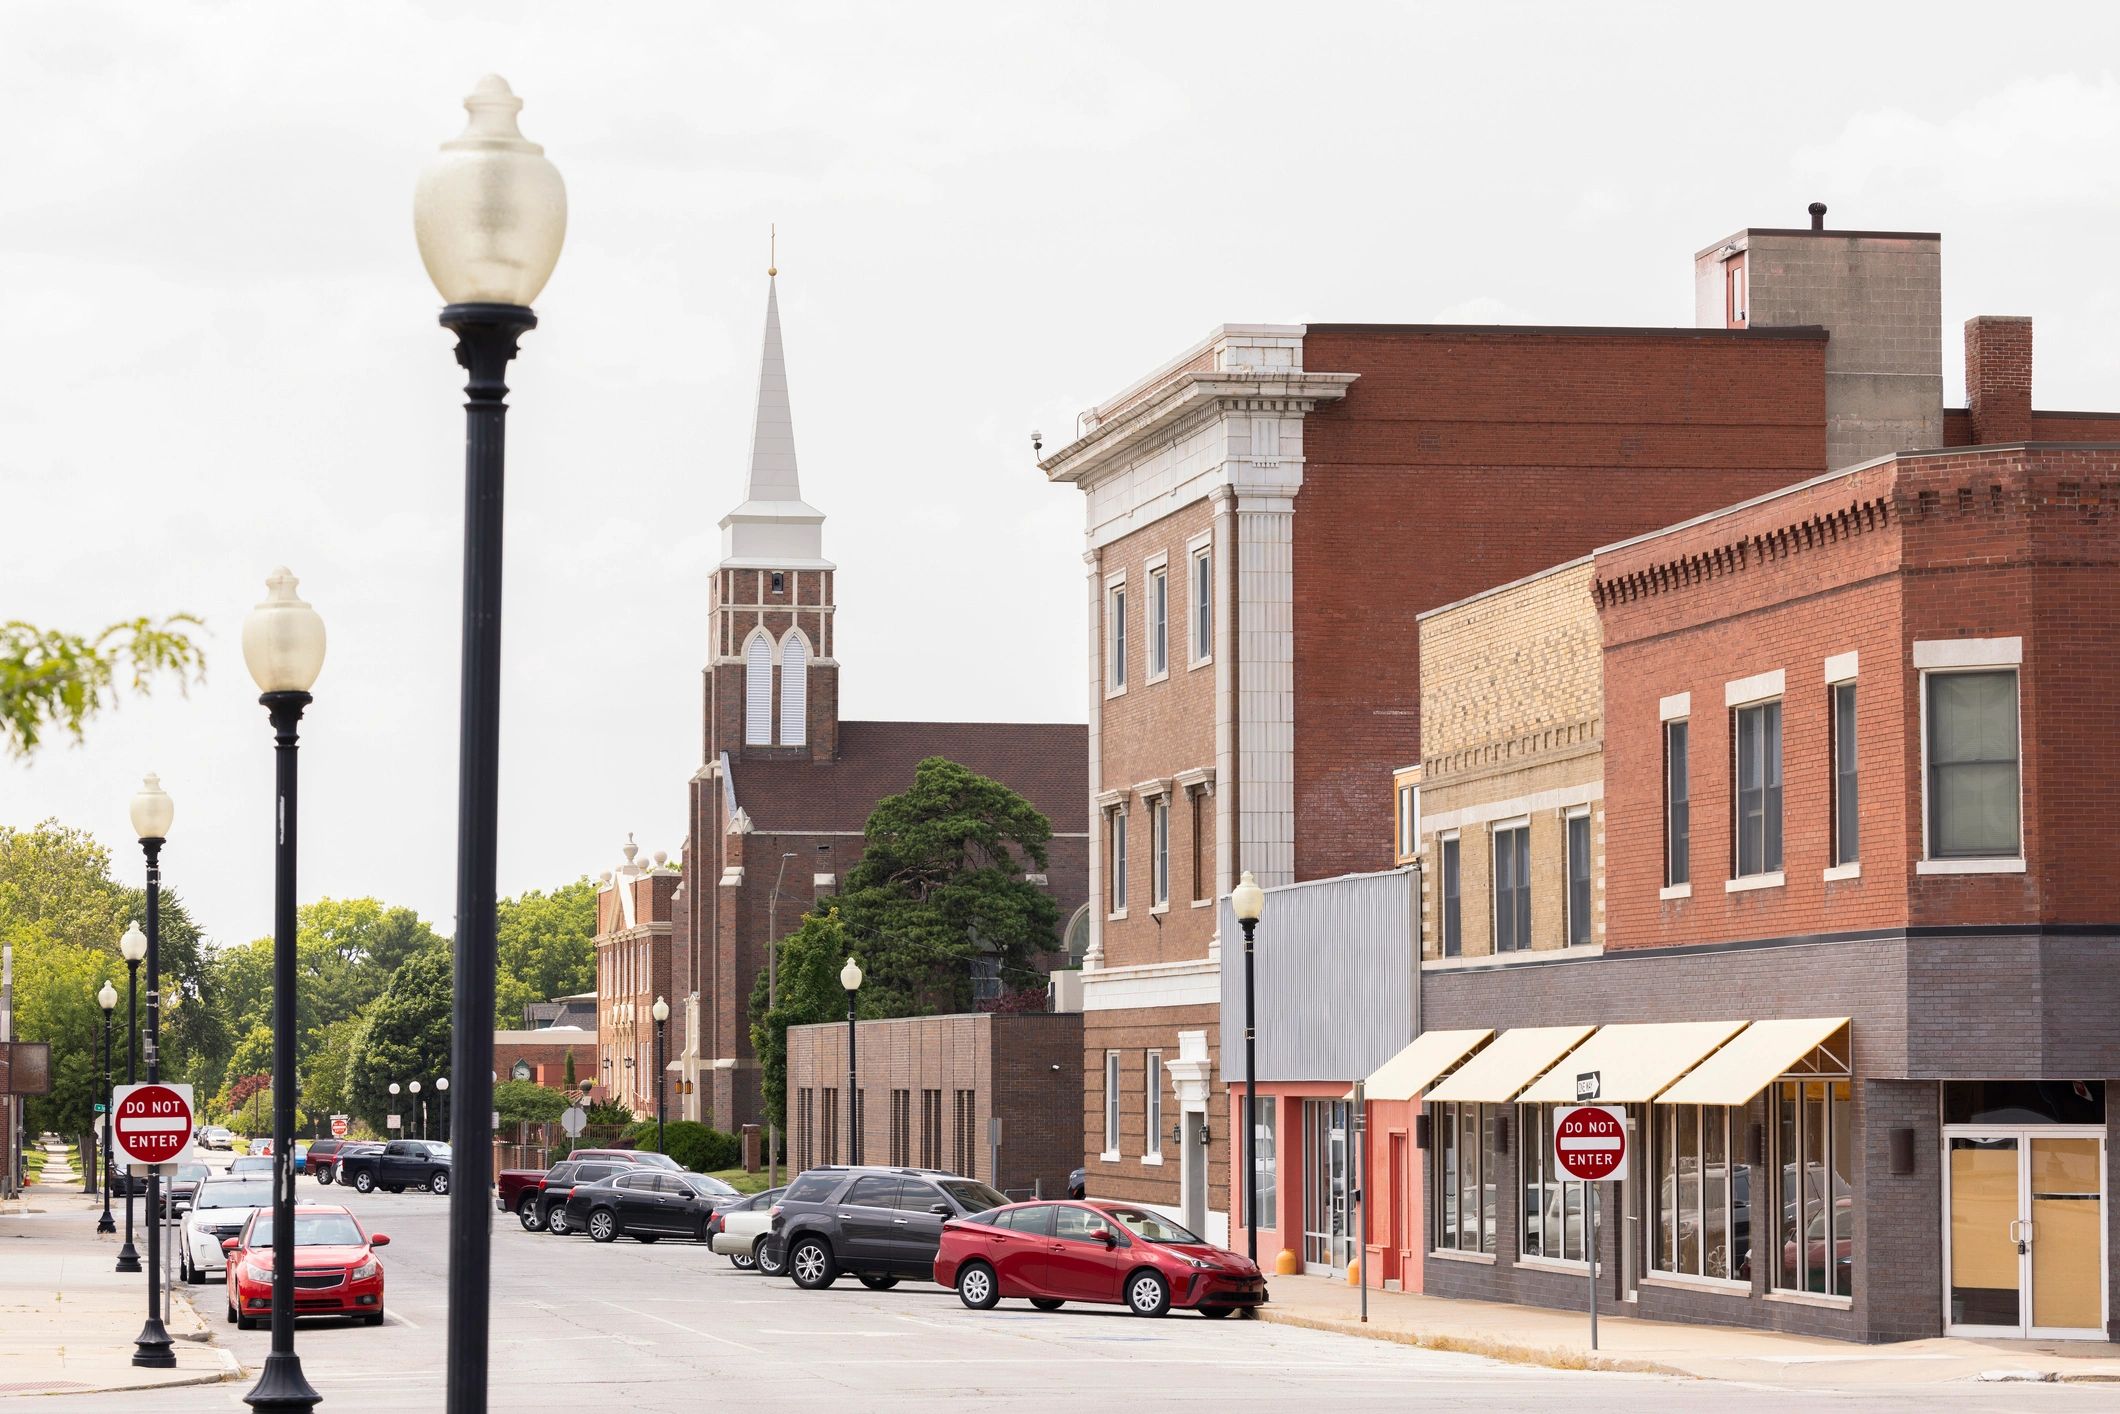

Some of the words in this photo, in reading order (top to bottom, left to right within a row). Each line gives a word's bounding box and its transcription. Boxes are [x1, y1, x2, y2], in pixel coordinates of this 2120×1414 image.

[127, 1102, 145, 1113] DO
[153, 1101, 180, 1113] NOT
[1566, 1122, 1583, 1133] DO
[1589, 1122, 1614, 1133] NOT
[130, 1135, 178, 1147] ENTER
[1569, 1154, 1612, 1165] ENTER
